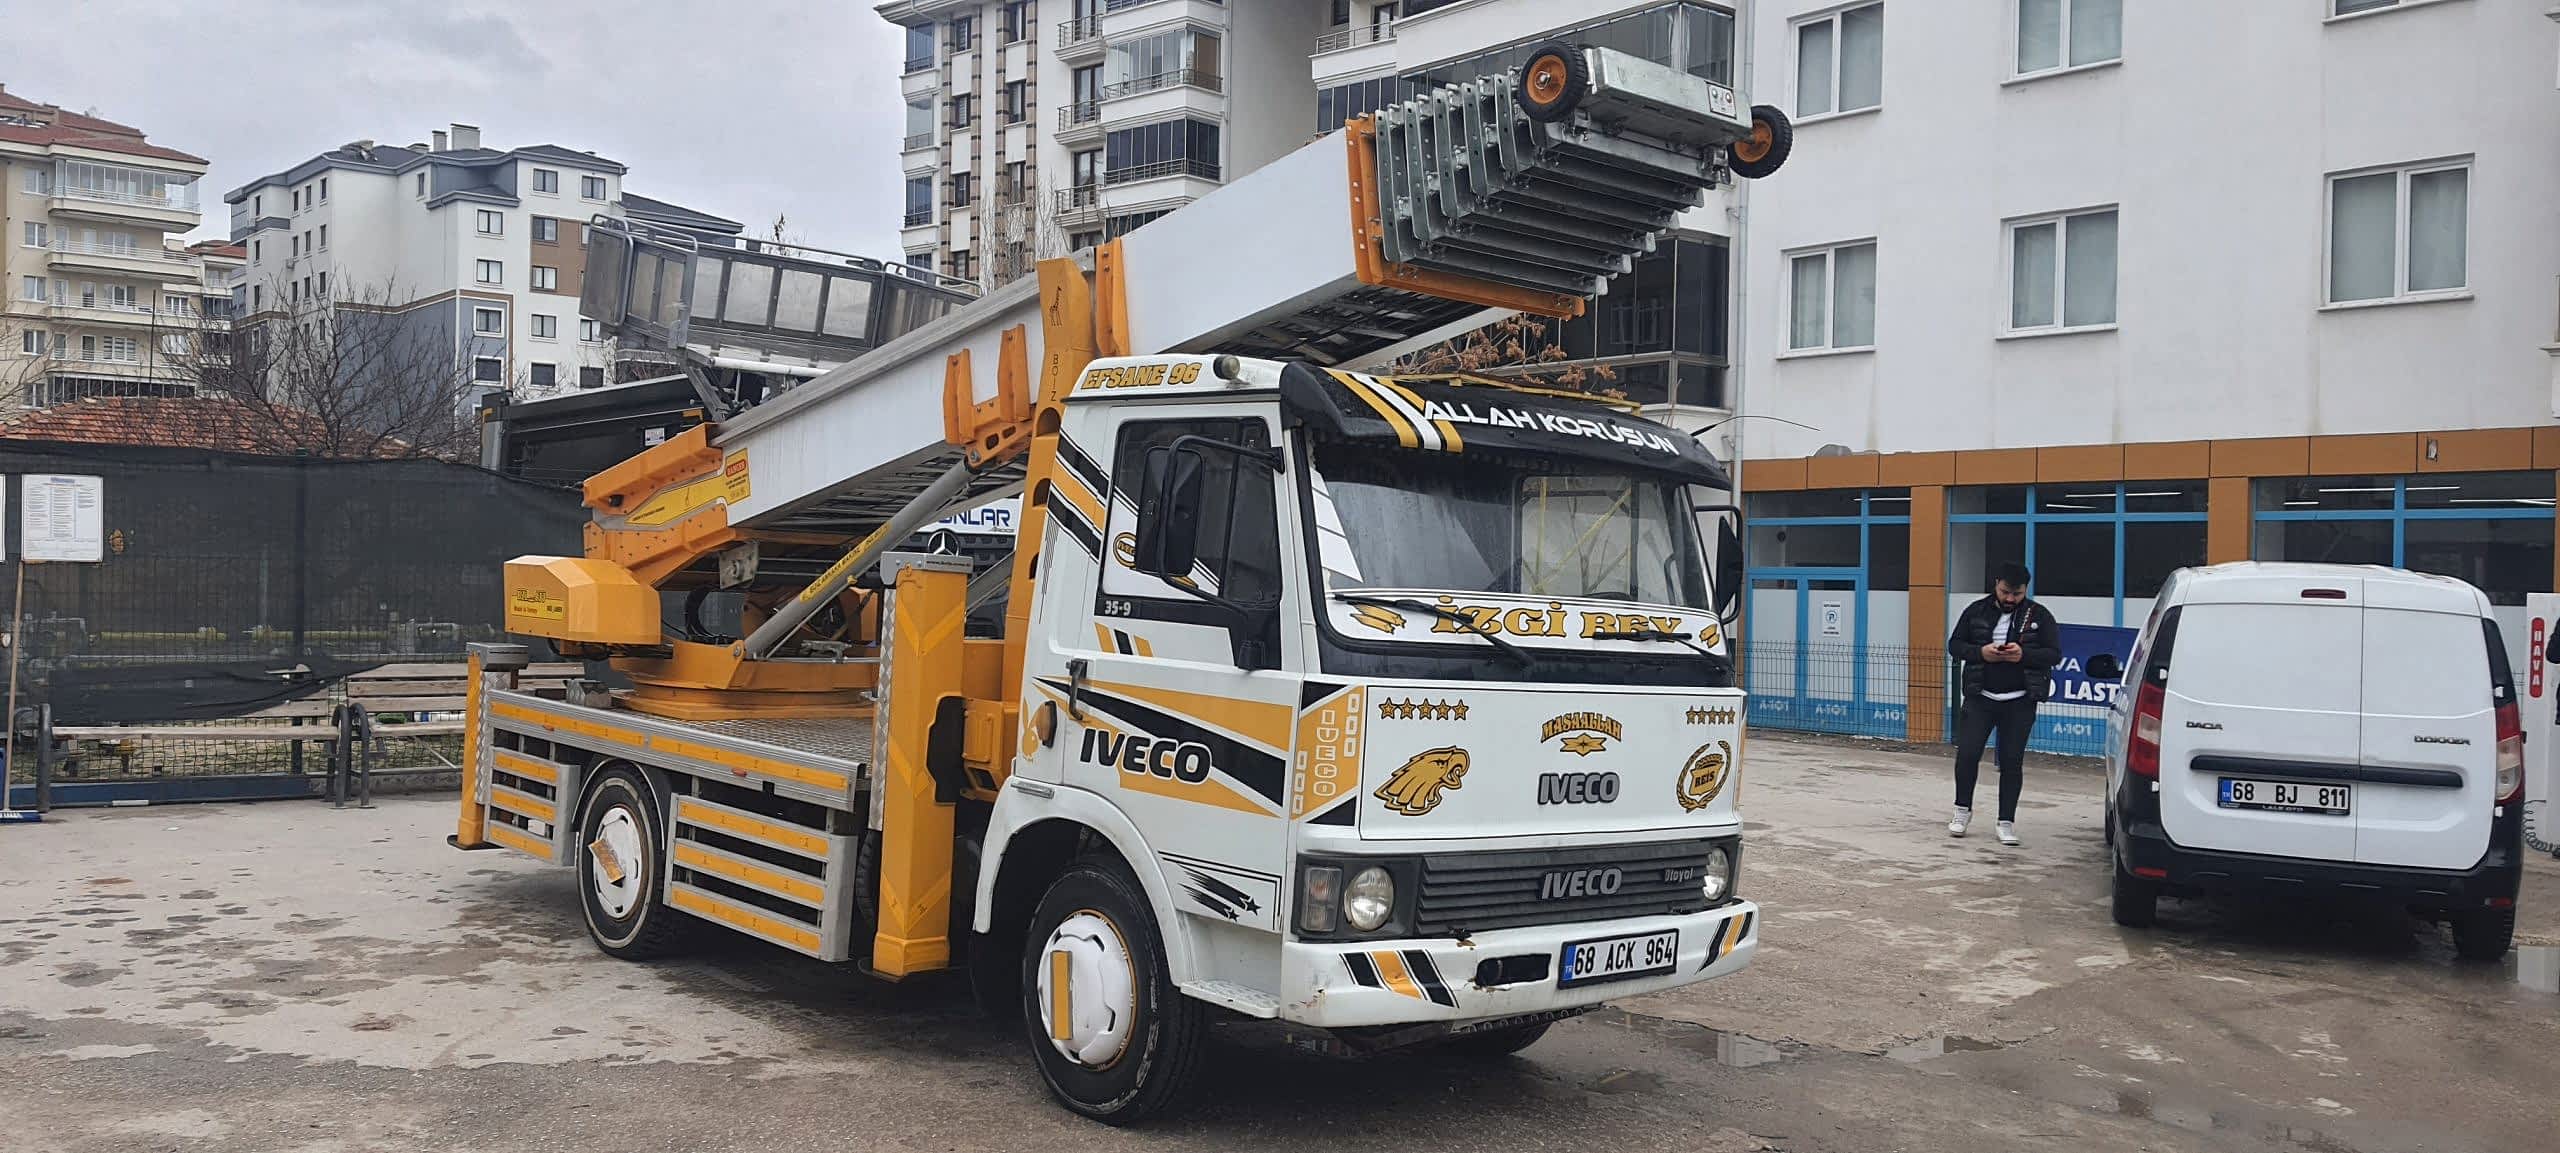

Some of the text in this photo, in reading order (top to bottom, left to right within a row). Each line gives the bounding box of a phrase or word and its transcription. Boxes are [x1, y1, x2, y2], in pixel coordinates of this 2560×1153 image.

[1080, 362, 1202, 389] EFSANE 96
[1423, 400, 1681, 455] ALLAH KORUSUN
[938, 508, 1011, 526] NLAR
[1104, 600, 1132, 616] 35-9
[1430, 595, 1567, 638] İZGİ
[2186, 720, 2223, 730] DACIA
[1079, 727, 1212, 785] IVECO
[1538, 772, 1621, 805] IVECO
[2233, 782, 2255, 801] 68
[2275, 784, 2299, 804] BJ
[2319, 788, 2347, 808] 811
[1542, 868, 1623, 900] IVECO
[1574, 946, 1596, 975] 68
[1604, 941, 1636, 972] ACK
[1645, 935, 1673, 966] 964
